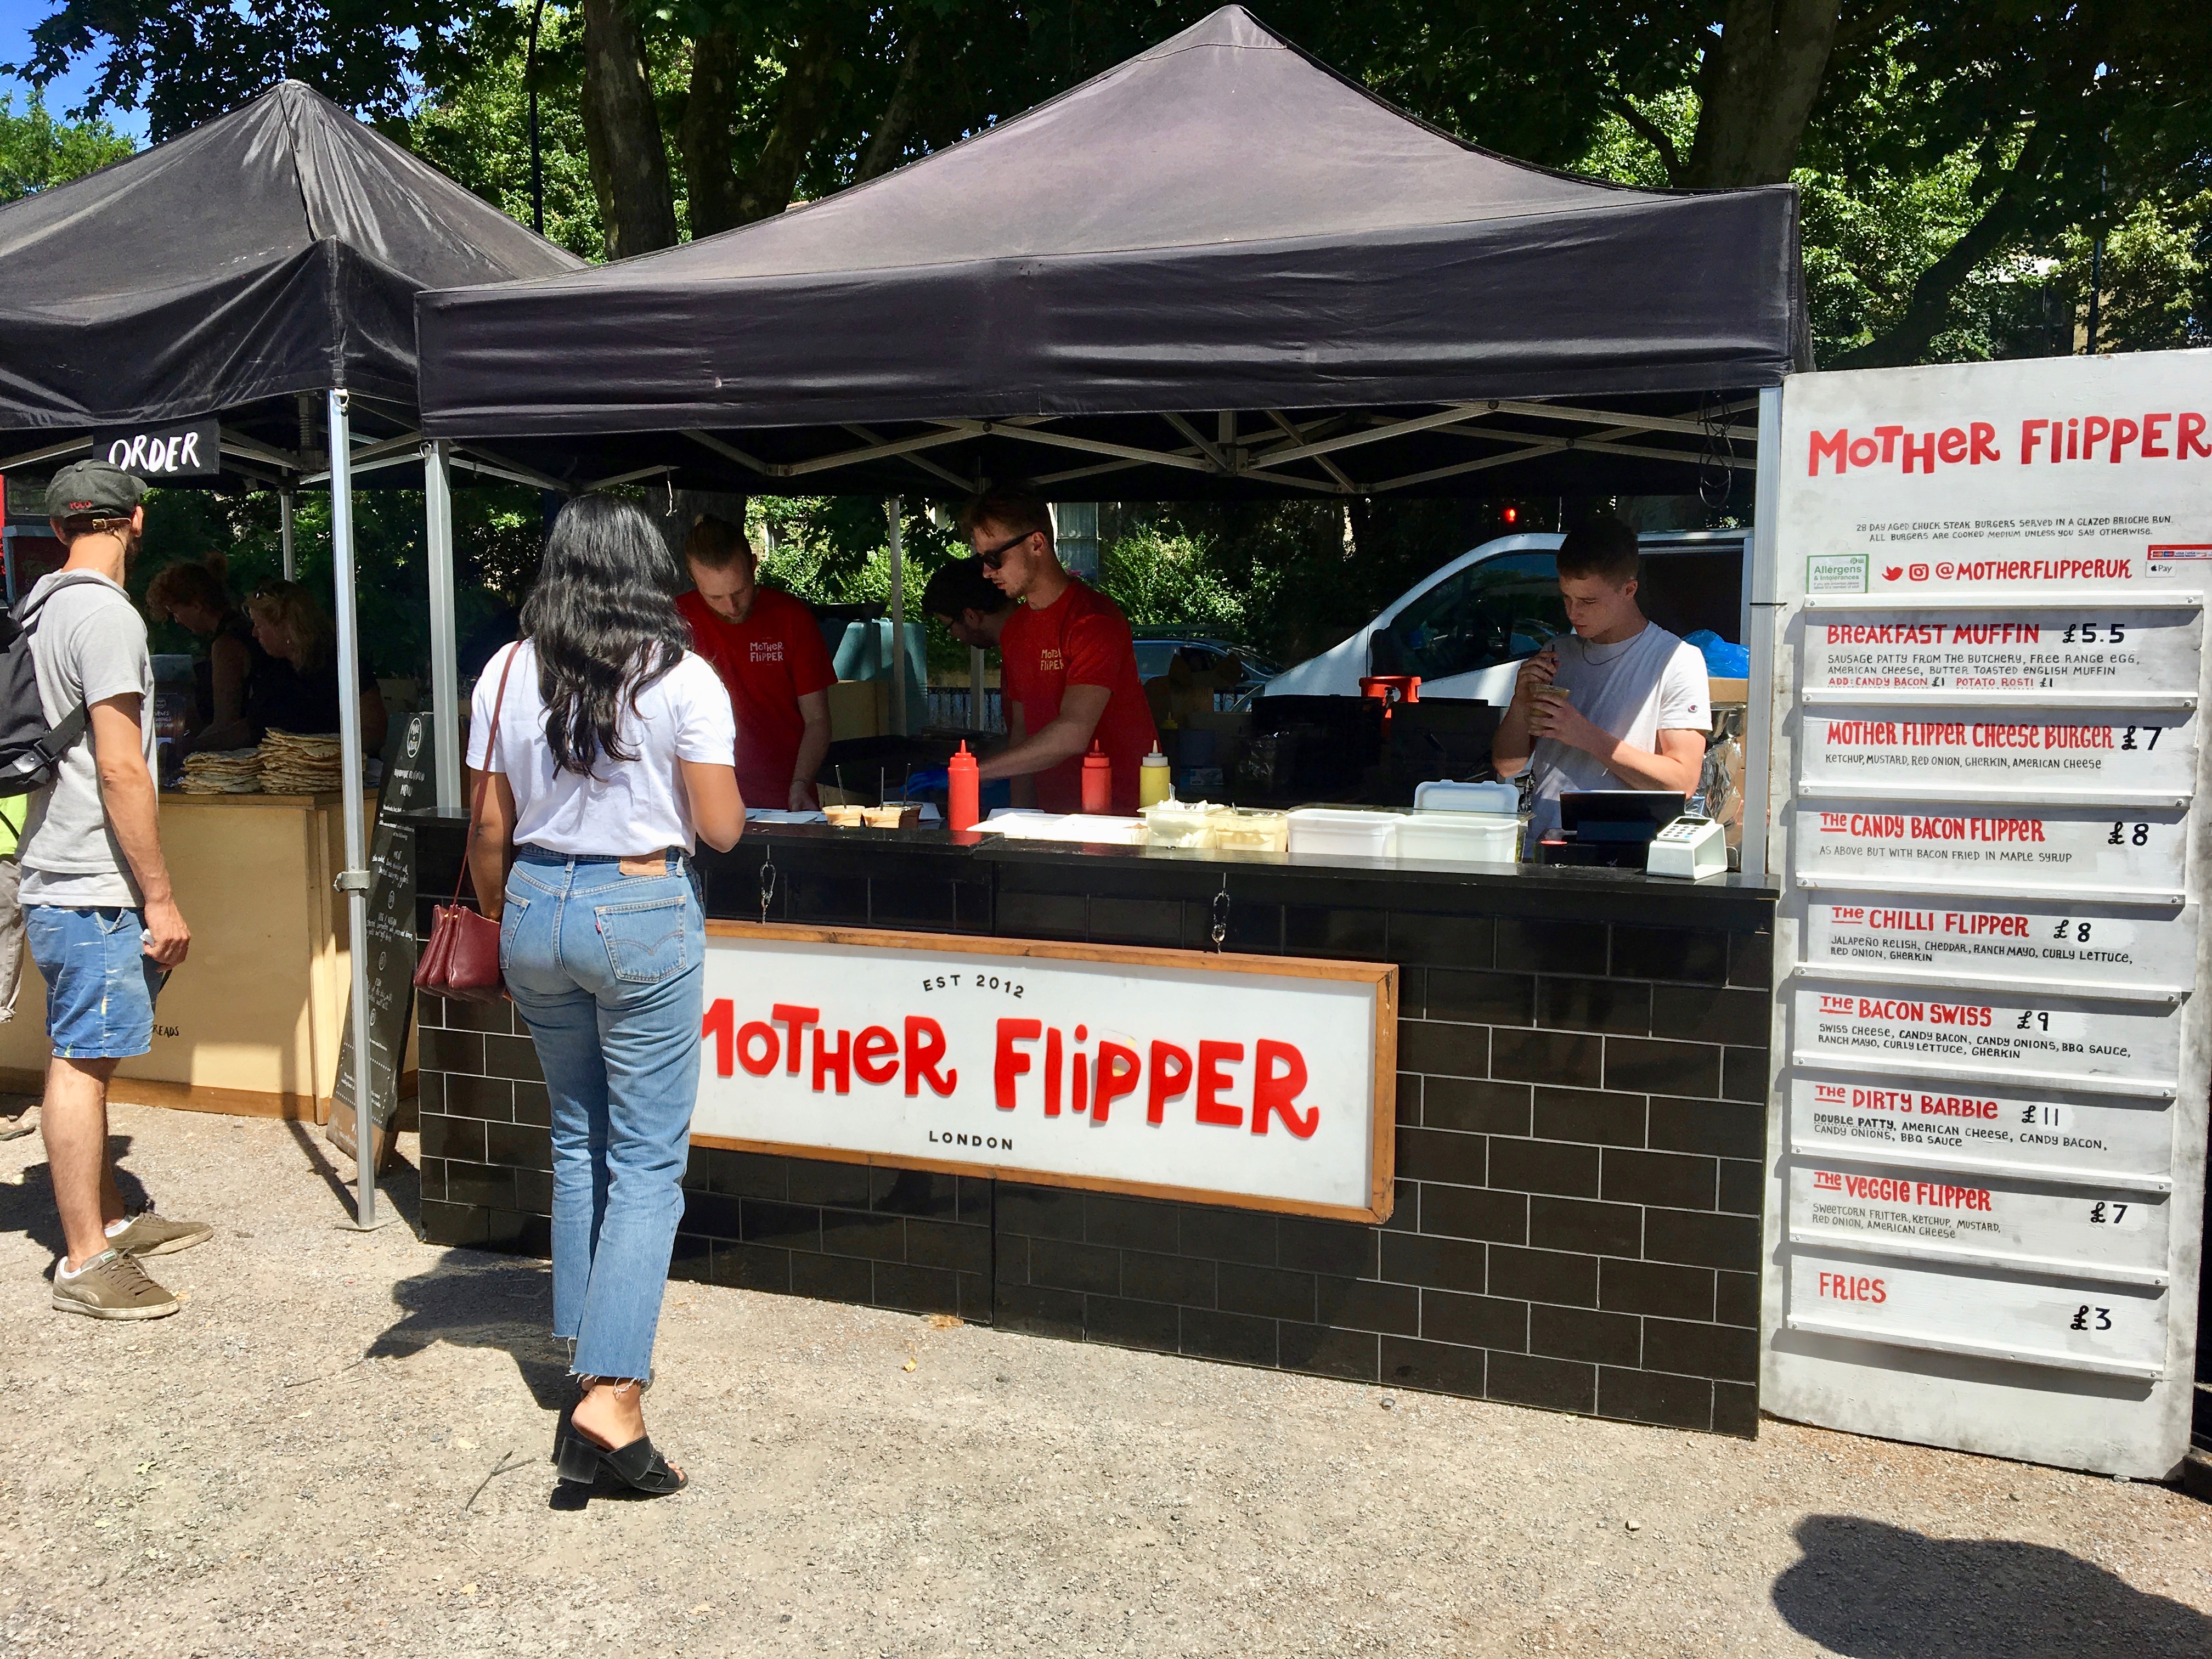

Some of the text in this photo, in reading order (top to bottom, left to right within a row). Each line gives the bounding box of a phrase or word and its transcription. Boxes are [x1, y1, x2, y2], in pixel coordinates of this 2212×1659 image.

[108, 432, 201, 472] ORDER
[1814, 566, 1862, 575] Allergens
[2158, 565, 2172, 574] Pay
[1953, 623, 2039, 645] MUFFIN
[1877, 654, 1907, 663] PATTY
[1913, 654, 1940, 663] FROM
[2073, 667, 2115, 675] MUFFIN
[1829, 678, 1853, 686] ADD:
[1856, 678, 1891, 686] CANDY
[1894, 678, 1928, 686] BACON
[1956, 678, 1995, 686] POTATO
[2001, 678, 2034, 687] ROSTI
[1866, 755, 1909, 766] MUSTARD,
[1932, 757, 1962, 768] ONION,
[1850, 814, 1904, 838] CANDY
[1911, 817, 1965, 839] BACON
[1820, 846, 1831, 855] AS
[1867, 847, 1885, 856] BUT
[1889, 848, 1912, 857] WITH
[1917, 849, 1948, 858] BACON
[1986, 851, 1995, 860] IN
[2039, 853, 2072, 862] SYRUP
[1869, 910, 1933, 930] CHILLI
[1852, 949, 1886, 960] ONION,
[1974, 944, 2004, 955] RANCH
[2007, 947, 2038, 958] MAYO,
[2042, 949, 2075, 960] CURLY
[923, 974, 1025, 999] EST 2012
[1859, 999, 1923, 1021] BACON
[1930, 1004, 1991, 1027] SWISS
[1819, 1035, 1848, 1045] RANCH
[1851, 1038, 1880, 1048] MAYO,
[1883, 1040, 1914, 1049] CURLY
[1820, 1024, 1848, 1033] SWISS
[1899, 1030, 1932, 1040] CANDY
[1936, 1033, 1971, 1045] BACON,
[1977, 1036, 2010, 1046] CANDY
[2014, 1039, 2058, 1052] ONIONS,
[2062, 1043, 2084, 1053] BBQ
[1853, 1090, 1912, 1112] DIRTY
[929, 1130, 1013, 1151] LONDON
[1815, 1124, 1847, 1136] CANDY
[1852, 1128, 1895, 1141] ONIONS,
[1901, 1133, 1922, 1143] BBQ
[1858, 1118, 1897, 1131] PATTY,
[2020, 1133, 2058, 1145] CANDY
[2063, 1137, 2107, 1150] BACON,
[1832, 1217, 1863, 1229] ONION,
[1957, 1220, 2000, 1233] MUSTARD,
